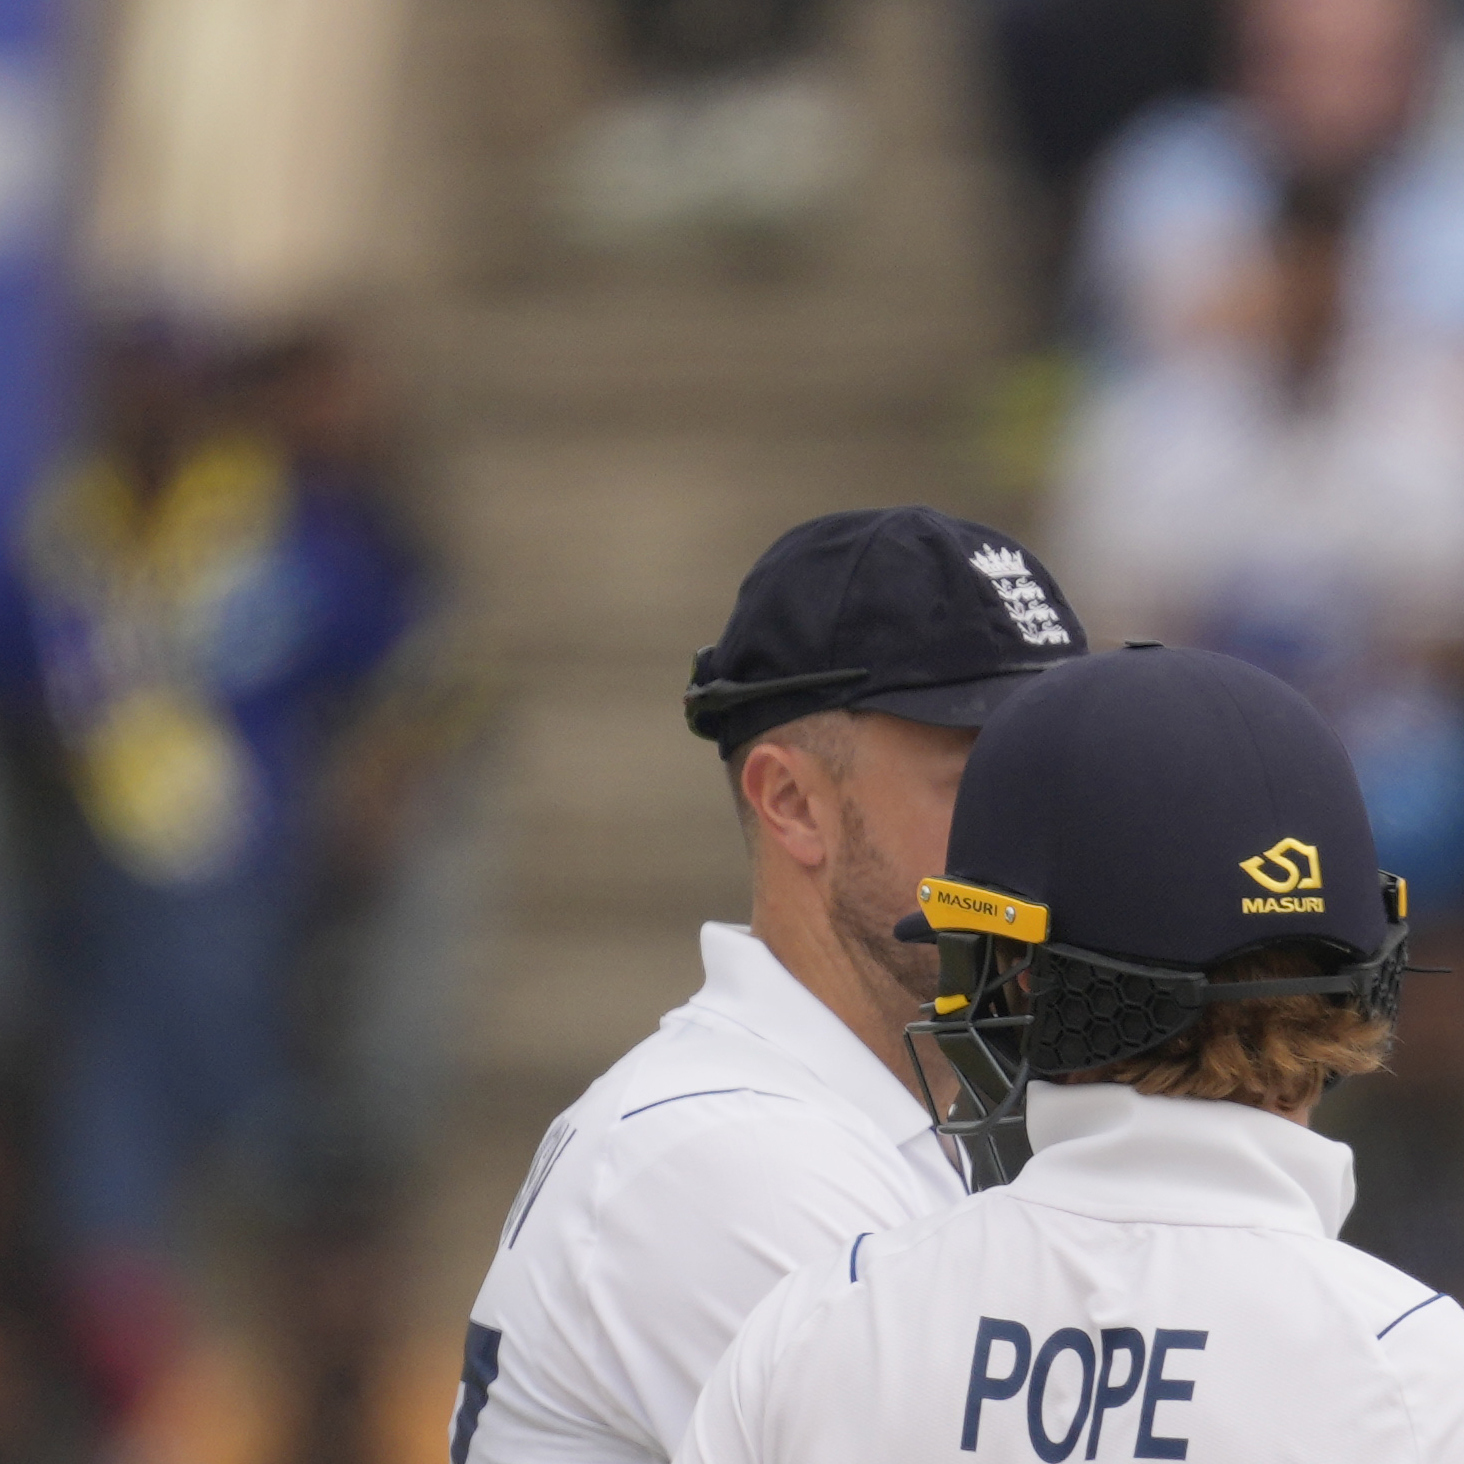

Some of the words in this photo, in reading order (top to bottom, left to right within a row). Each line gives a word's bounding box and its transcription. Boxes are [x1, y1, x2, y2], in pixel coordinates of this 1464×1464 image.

[937, 891, 998, 917] MASURI
[1241, 897, 1325, 914] MASURI
[960, 1316, 1208, 1464] POPE
